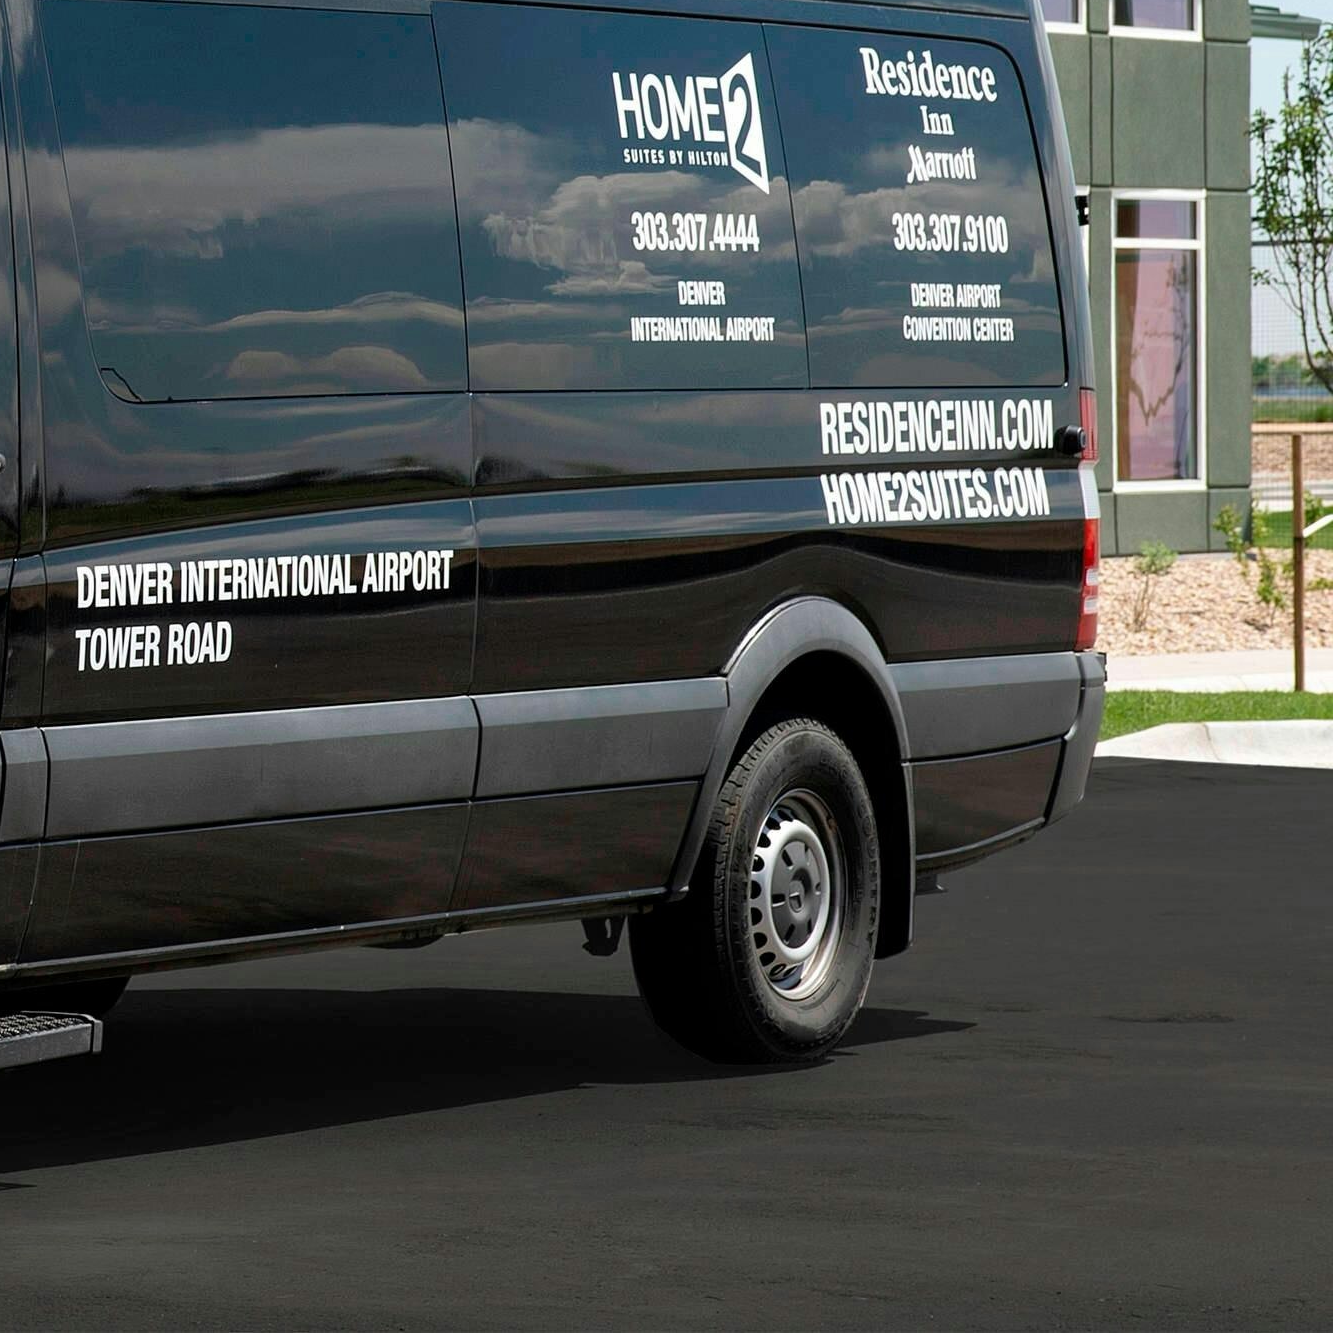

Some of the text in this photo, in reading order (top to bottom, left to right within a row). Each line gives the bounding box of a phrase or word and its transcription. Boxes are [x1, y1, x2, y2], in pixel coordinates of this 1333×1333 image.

[859, 46, 998, 103] Residence
[919, 104, 956, 137] Inn
[622, 147, 730, 167] SUITES BY HILTON
[906, 143, 978, 185] Marriott
[631, 211, 761, 253] 303.307.4444
[891, 212, 1010, 254] 303.307.9100
[677, 280, 727, 307] DENVER
[909, 282, 1002, 309] DENVER AIRPORT
[630, 316, 776, 343] INTERNATIONAL AIRPORT
[901, 314, 1016, 343] CONVENTION CENTER
[819, 398, 1055, 456] RESIDENCEINN.COM
[819, 466, 1052, 526] HOME2SUITES.COM
[75, 549, 455, 610] DENVER INTERNATIONAL AIRPORT
[74, 620, 233, 673] TOWER ROAD
